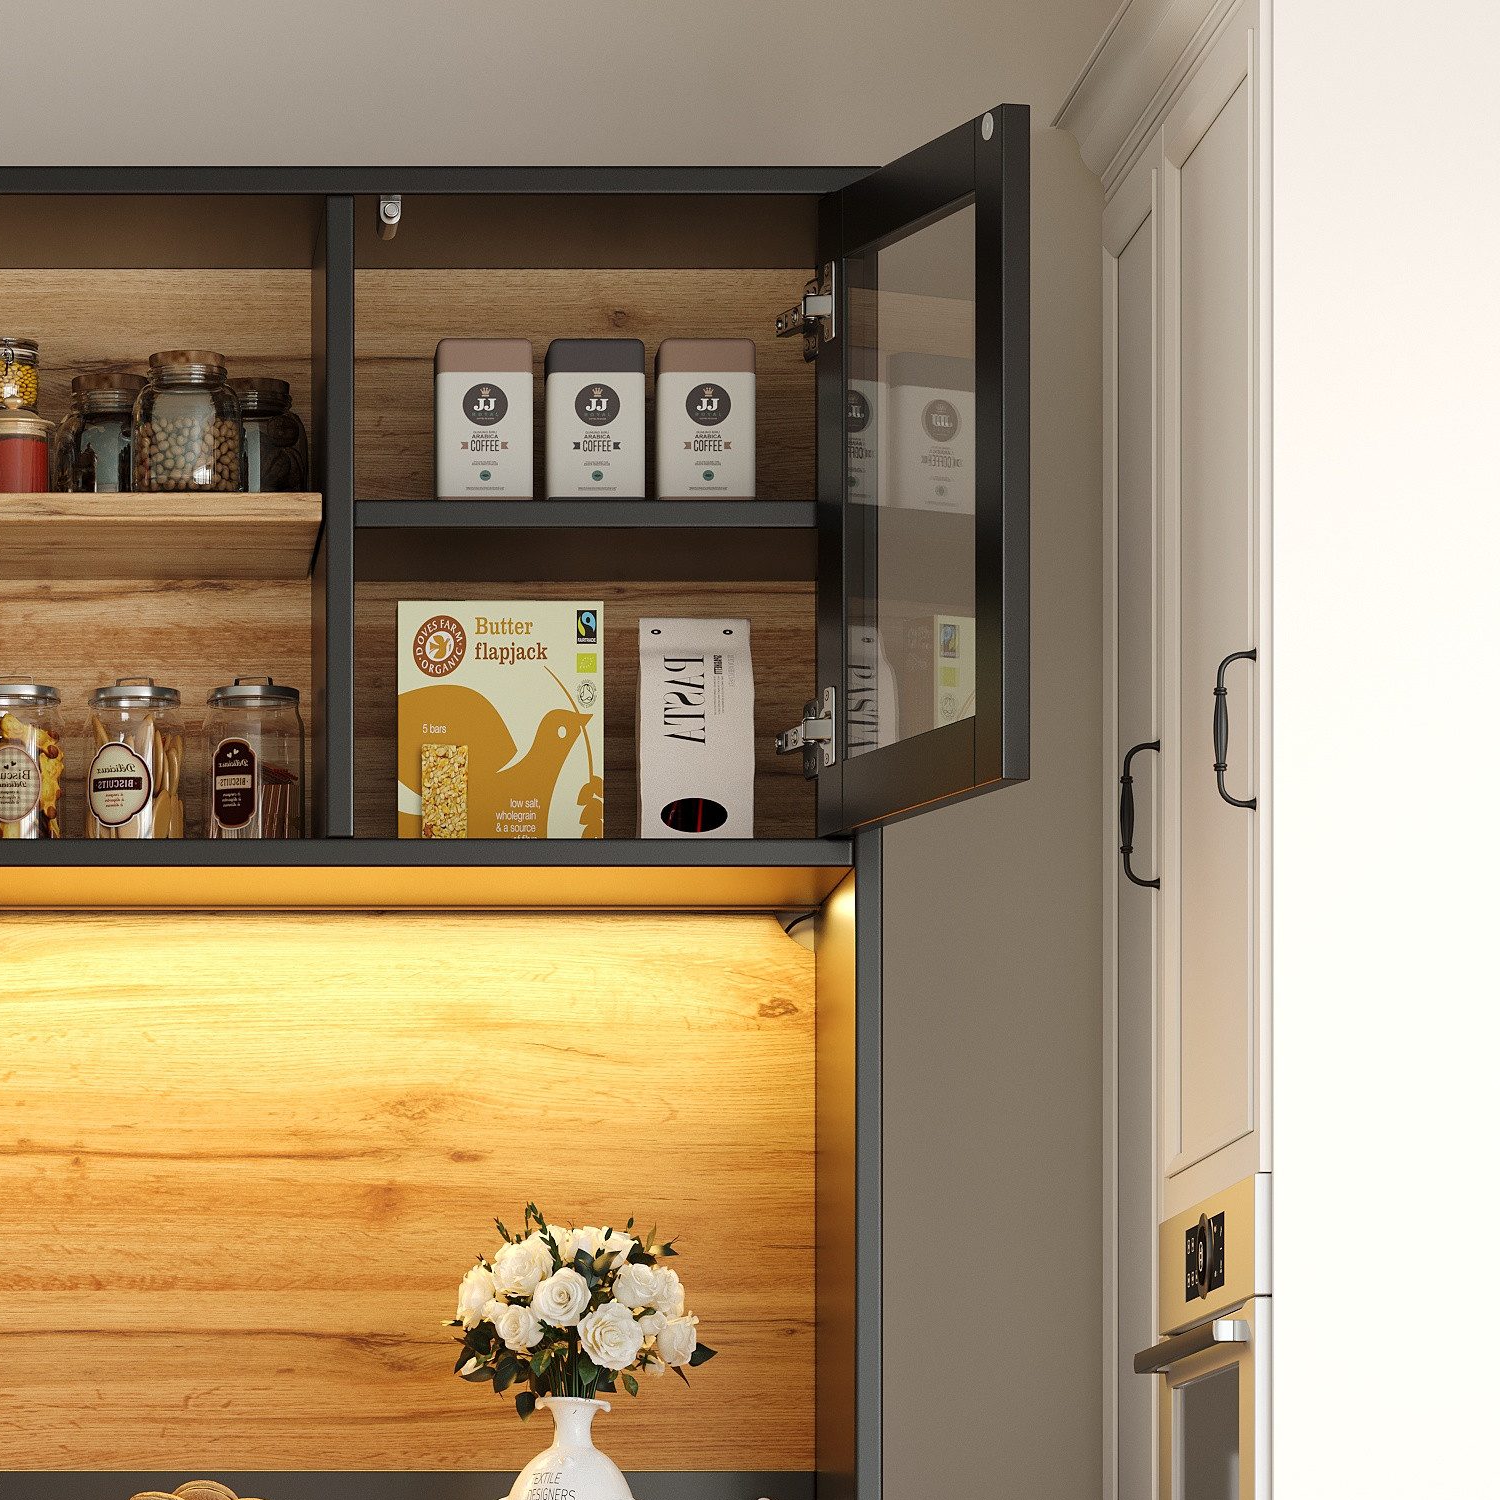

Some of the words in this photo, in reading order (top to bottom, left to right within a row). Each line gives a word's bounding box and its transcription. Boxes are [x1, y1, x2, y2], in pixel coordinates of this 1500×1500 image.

[473, 398, 496, 411] JJ
[585, 398, 609, 411] JJ
[696, 398, 719, 411] JJ
[470, 440, 500, 451] COFFEE
[583, 440, 611, 452] COFFEE
[694, 440, 722, 451] COFFEE
[474, 617, 533, 635] Butter
[415, 620, 438, 656] DOVES
[440, 620, 463, 643] FARM
[475, 642, 548, 665] flapjack
[421, 648, 462, 674] ORGANIC
[422, 724, 428, 733] 5
[430, 724, 446, 733] bars
[510, 798, 523, 808] low
[525, 798, 540, 809] salt,
[496, 810, 536, 822] wholegrain
[496, 823, 501, 832] &
[504, 824, 508, 832] a
[510, 824, 536, 832] source
[533, 1472, 562, 1484] TEXTILE
